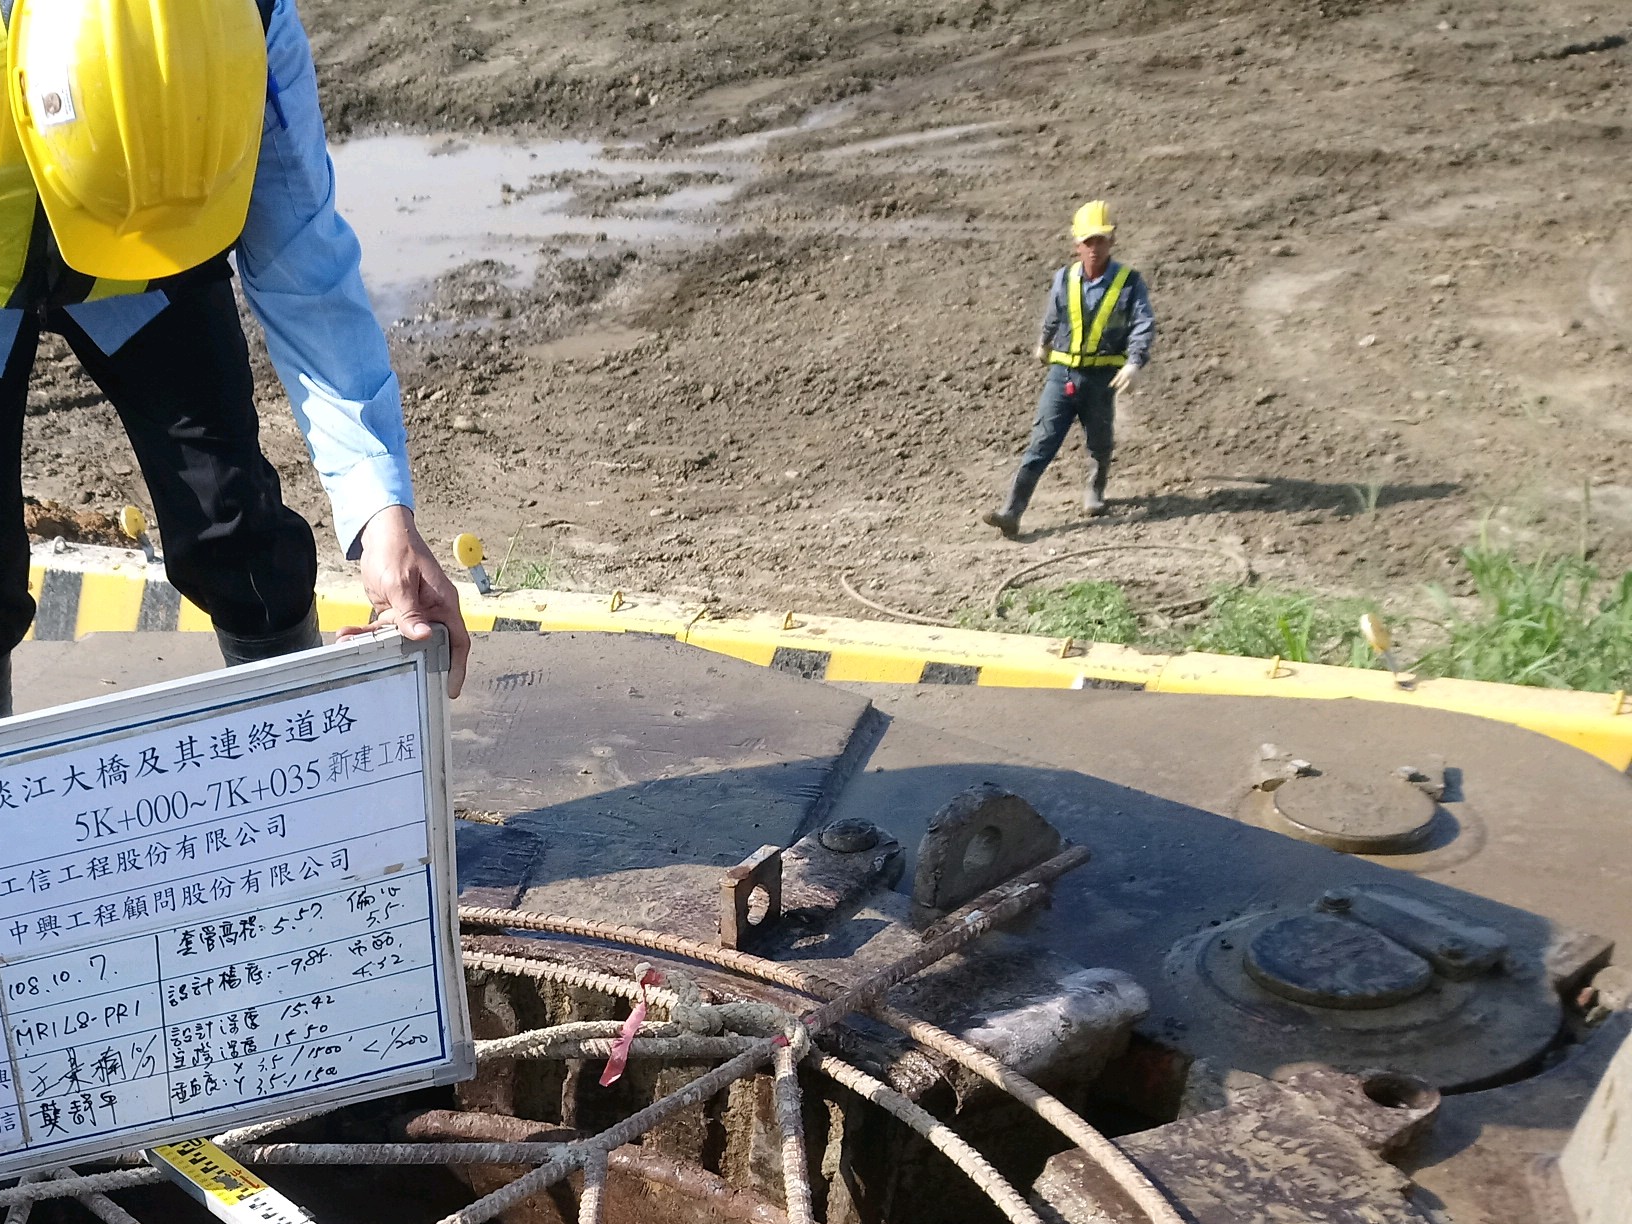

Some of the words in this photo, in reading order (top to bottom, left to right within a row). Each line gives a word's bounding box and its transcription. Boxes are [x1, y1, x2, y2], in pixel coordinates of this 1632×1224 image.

[74, 758, 322, 843] 5K+000~7K+035
[326, 732, 417, 784] 新建工程
[0, 812, 287, 898] 工信工程股份有限公司
[9, 847, 351, 947] 中興工程顧問股份有限公司
